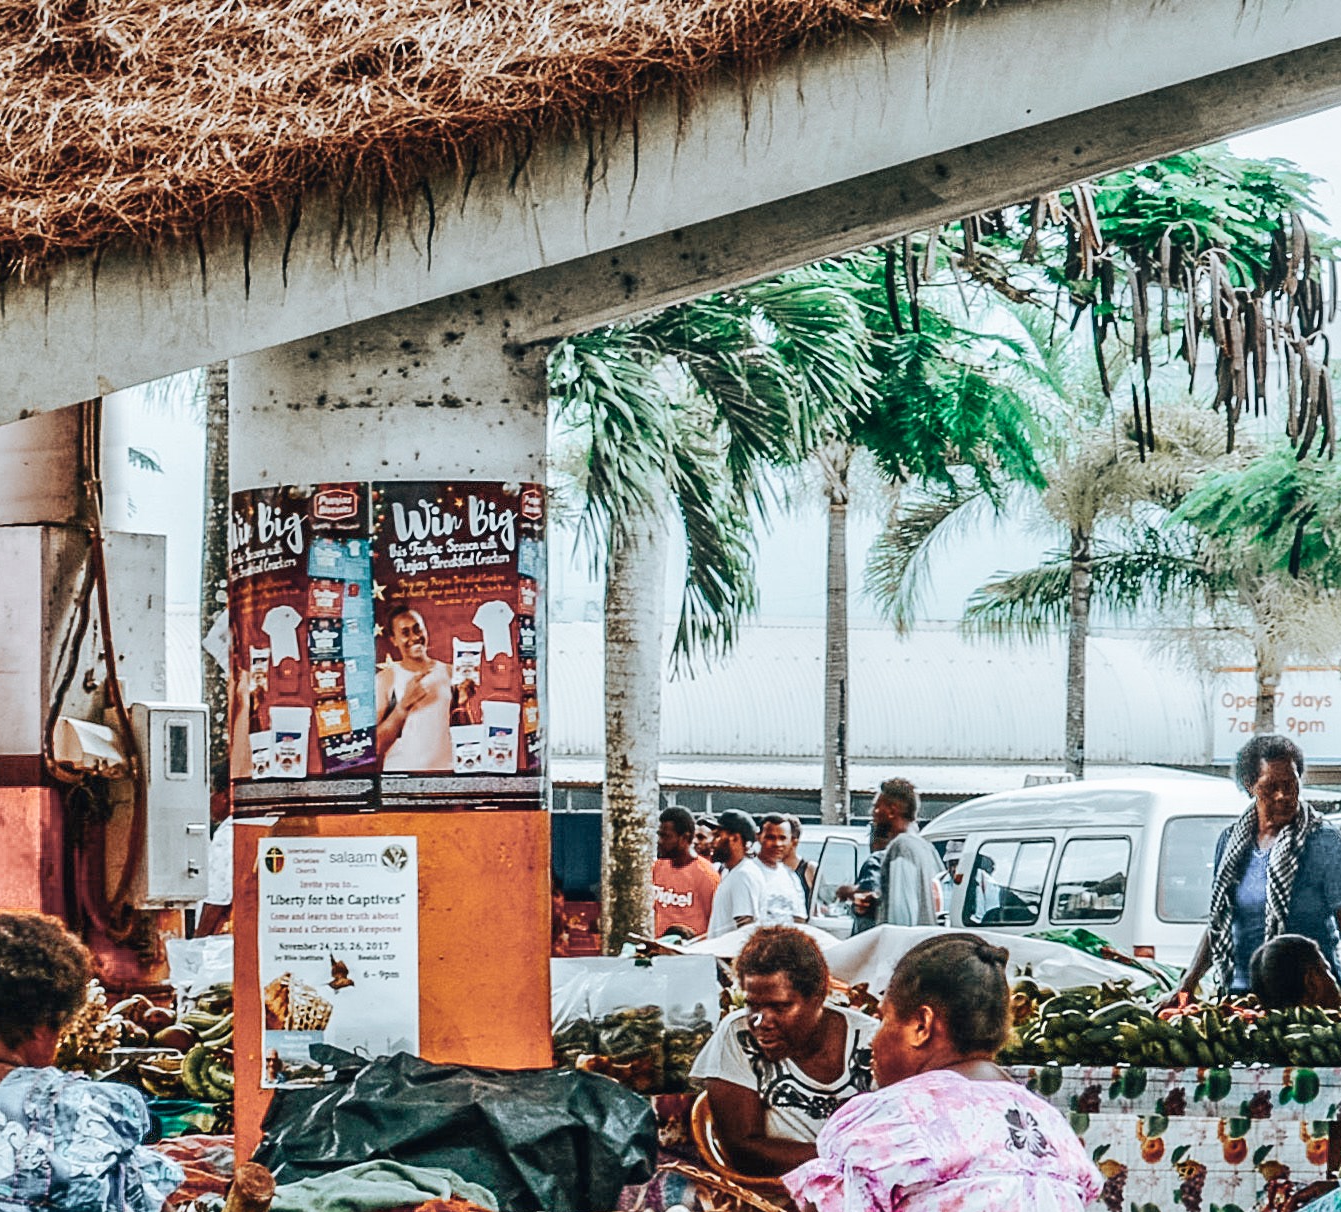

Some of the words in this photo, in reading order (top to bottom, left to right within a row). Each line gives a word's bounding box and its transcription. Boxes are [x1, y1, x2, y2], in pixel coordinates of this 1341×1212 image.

[258, 502, 308, 554] Big
[392, 499, 462, 542] Win
[468, 495, 518, 550] Big
[447, 538, 479, 552] Season
[394, 558, 428, 576] Punjas
[430, 555, 475, 569] Breakfast
[476, 551, 510, 566] Crackers
[1221, 692, 1258, 712] Ope
[1292, 691, 1332, 711] days
[1286, 717, 1325, 736] 9pm
[329, 851, 378, 864] salaam
[325, 882, 340, 890] you
[308, 894, 324, 906] for
[326, 894, 344, 906] the
[292, 912, 305, 920] and
[330, 912, 344, 920] the
[346, 912, 370, 920] truth
[372, 912, 399, 920] about
[289, 925, 303, 933] and
[358, 926, 402, 935] Response
[278, 942, 317, 951] November
[366, 942, 390, 950] 2017
[379, 970, 400, 980] 9pm
